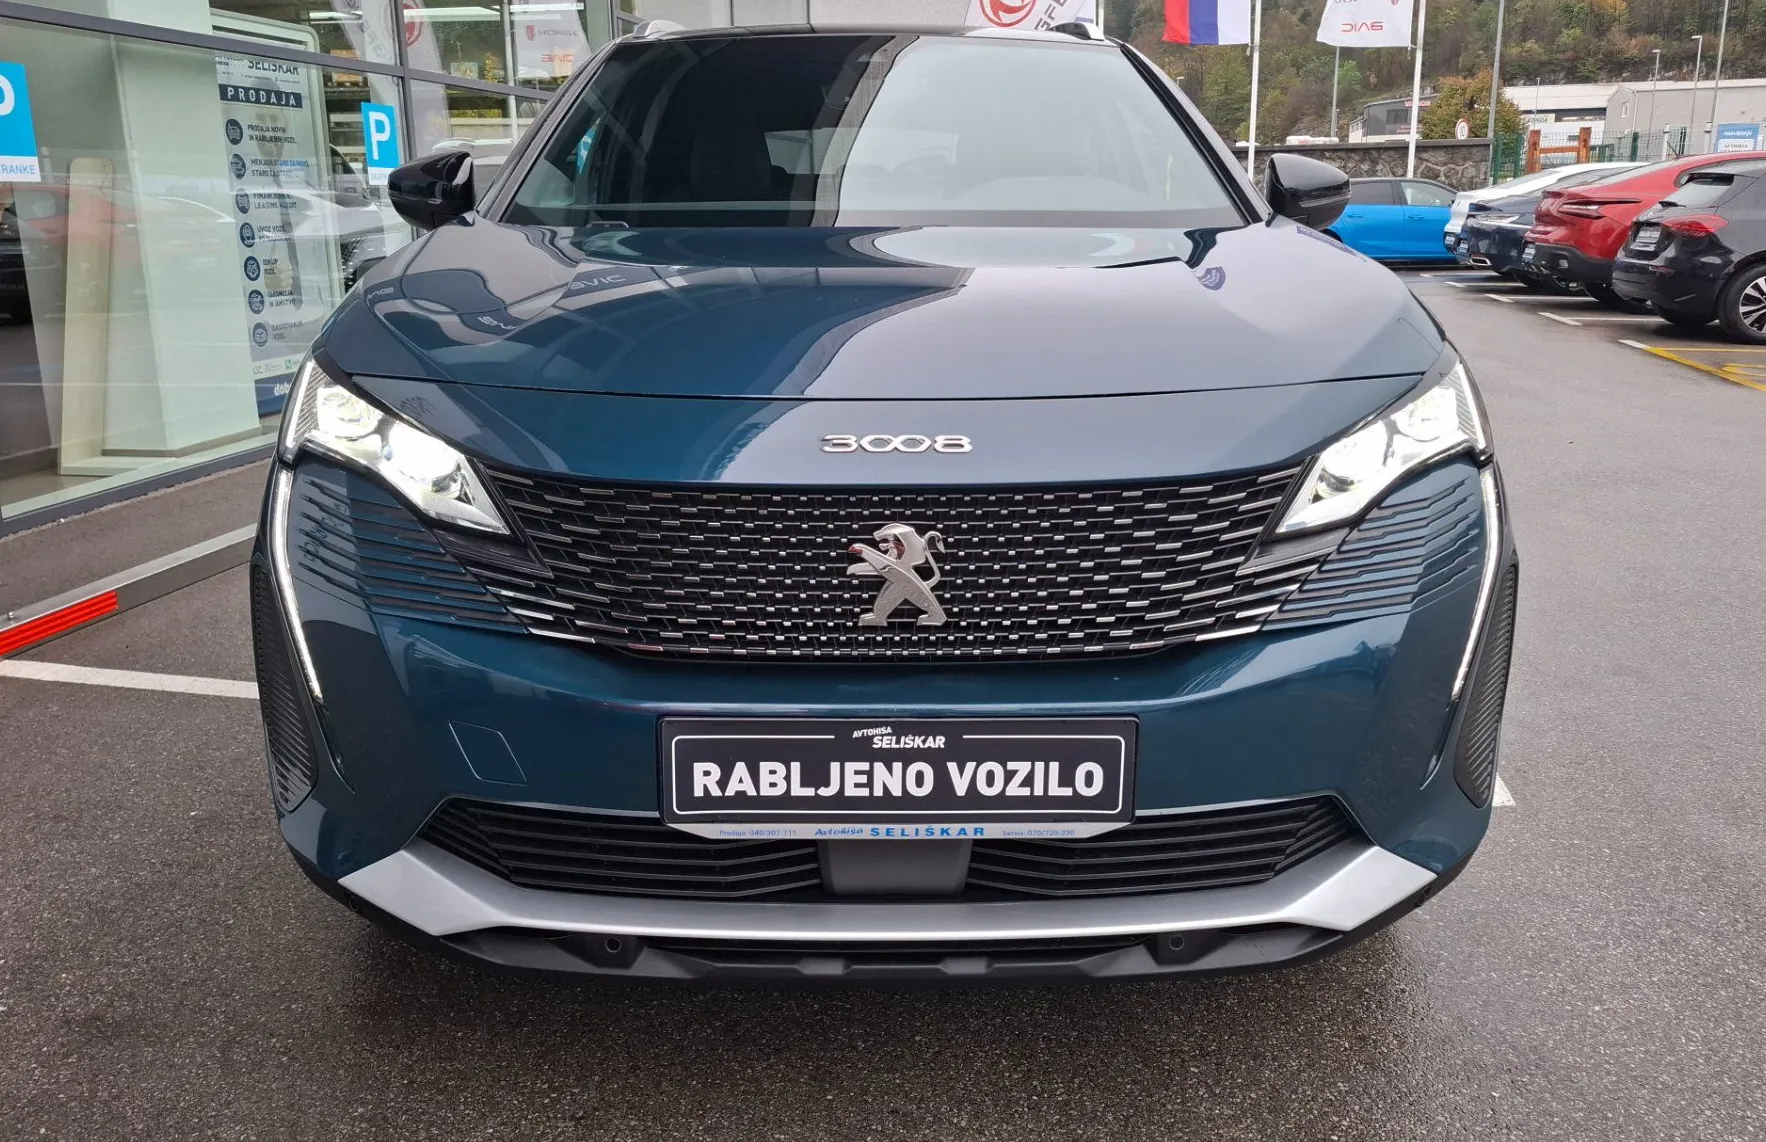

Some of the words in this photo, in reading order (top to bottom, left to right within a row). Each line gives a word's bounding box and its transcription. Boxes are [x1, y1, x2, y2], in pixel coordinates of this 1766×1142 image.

[227, 86, 297, 107] PRODAJA
[368, 111, 391, 160] P
[820, 434, 973, 453] 3008
[872, 734, 946, 749] SELIŠKAR
[692, 761, 934, 798] RABLJENO
[946, 761, 1104, 798] VOZILO
[869, 825, 986, 837] SELIŠKAR
